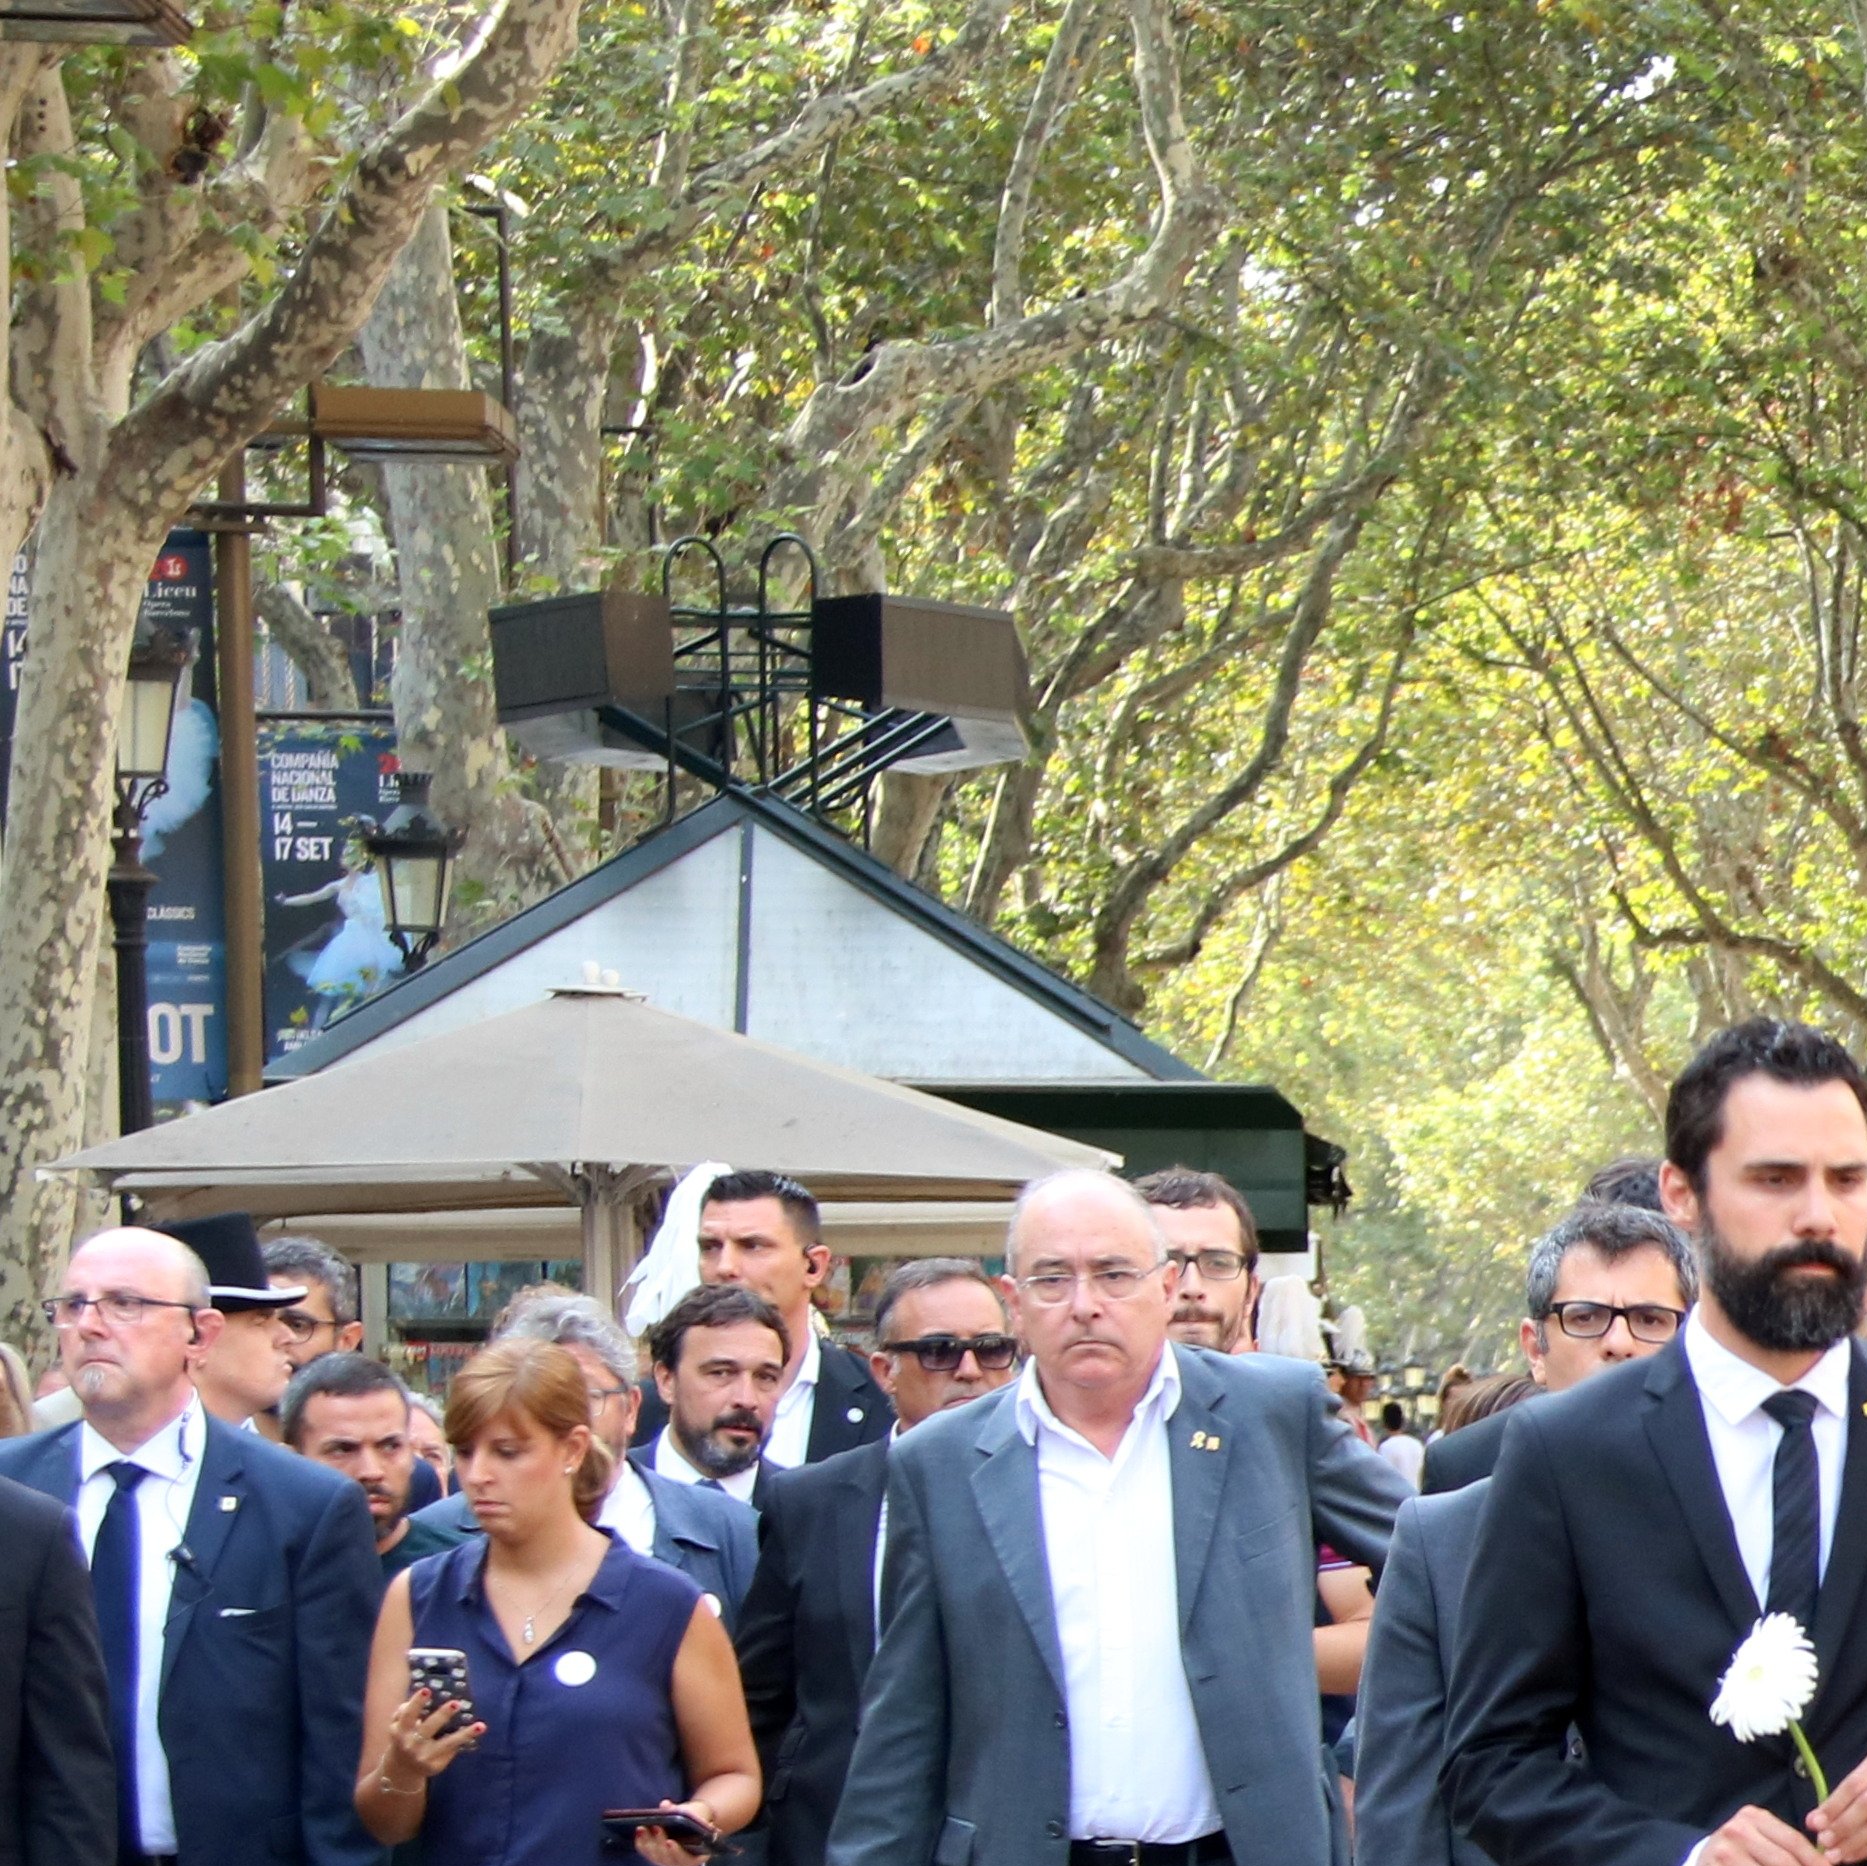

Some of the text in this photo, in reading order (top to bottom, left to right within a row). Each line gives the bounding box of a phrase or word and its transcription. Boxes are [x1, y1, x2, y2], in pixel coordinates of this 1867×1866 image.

[271, 750, 339, 769] COMPAÑÍA
[271, 770, 337, 786] NACIONAL
[271, 785, 336, 803] DE DANZA
[274, 812, 293, 835] 14
[275, 837, 333, 861] 17 SET
